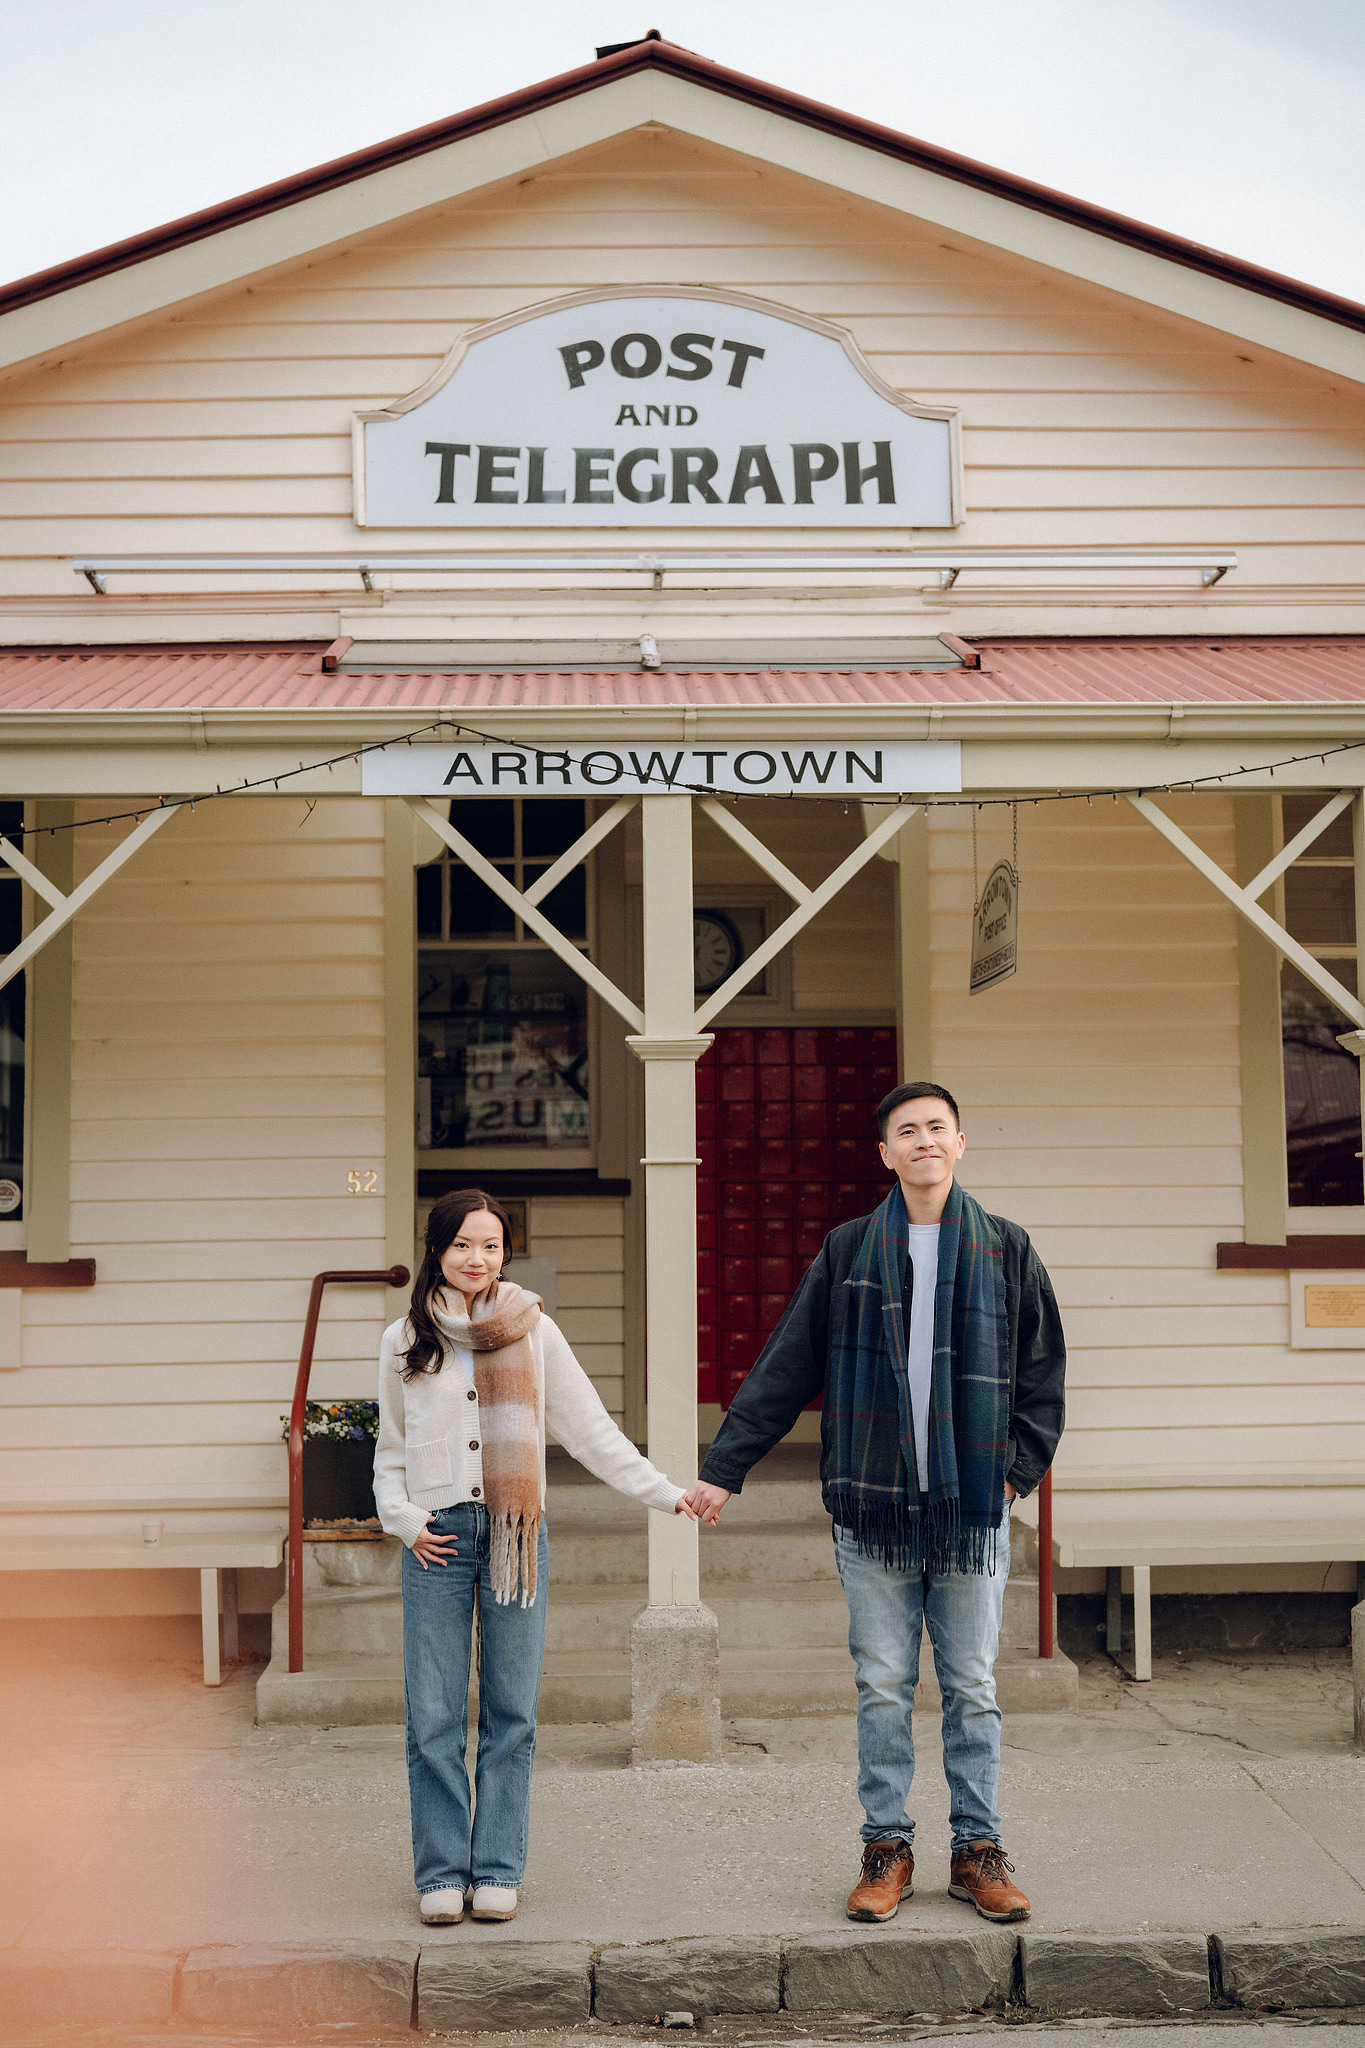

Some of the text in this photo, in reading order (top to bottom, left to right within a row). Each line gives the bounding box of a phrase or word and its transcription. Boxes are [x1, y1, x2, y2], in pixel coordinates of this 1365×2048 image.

[557, 332, 766, 390] POST
[615, 404, 698, 427] AND
[424, 440, 897, 505] TELEGRAPH
[442, 750, 884, 786] ARROWTOWN
[346, 1170, 378, 1193] 52
